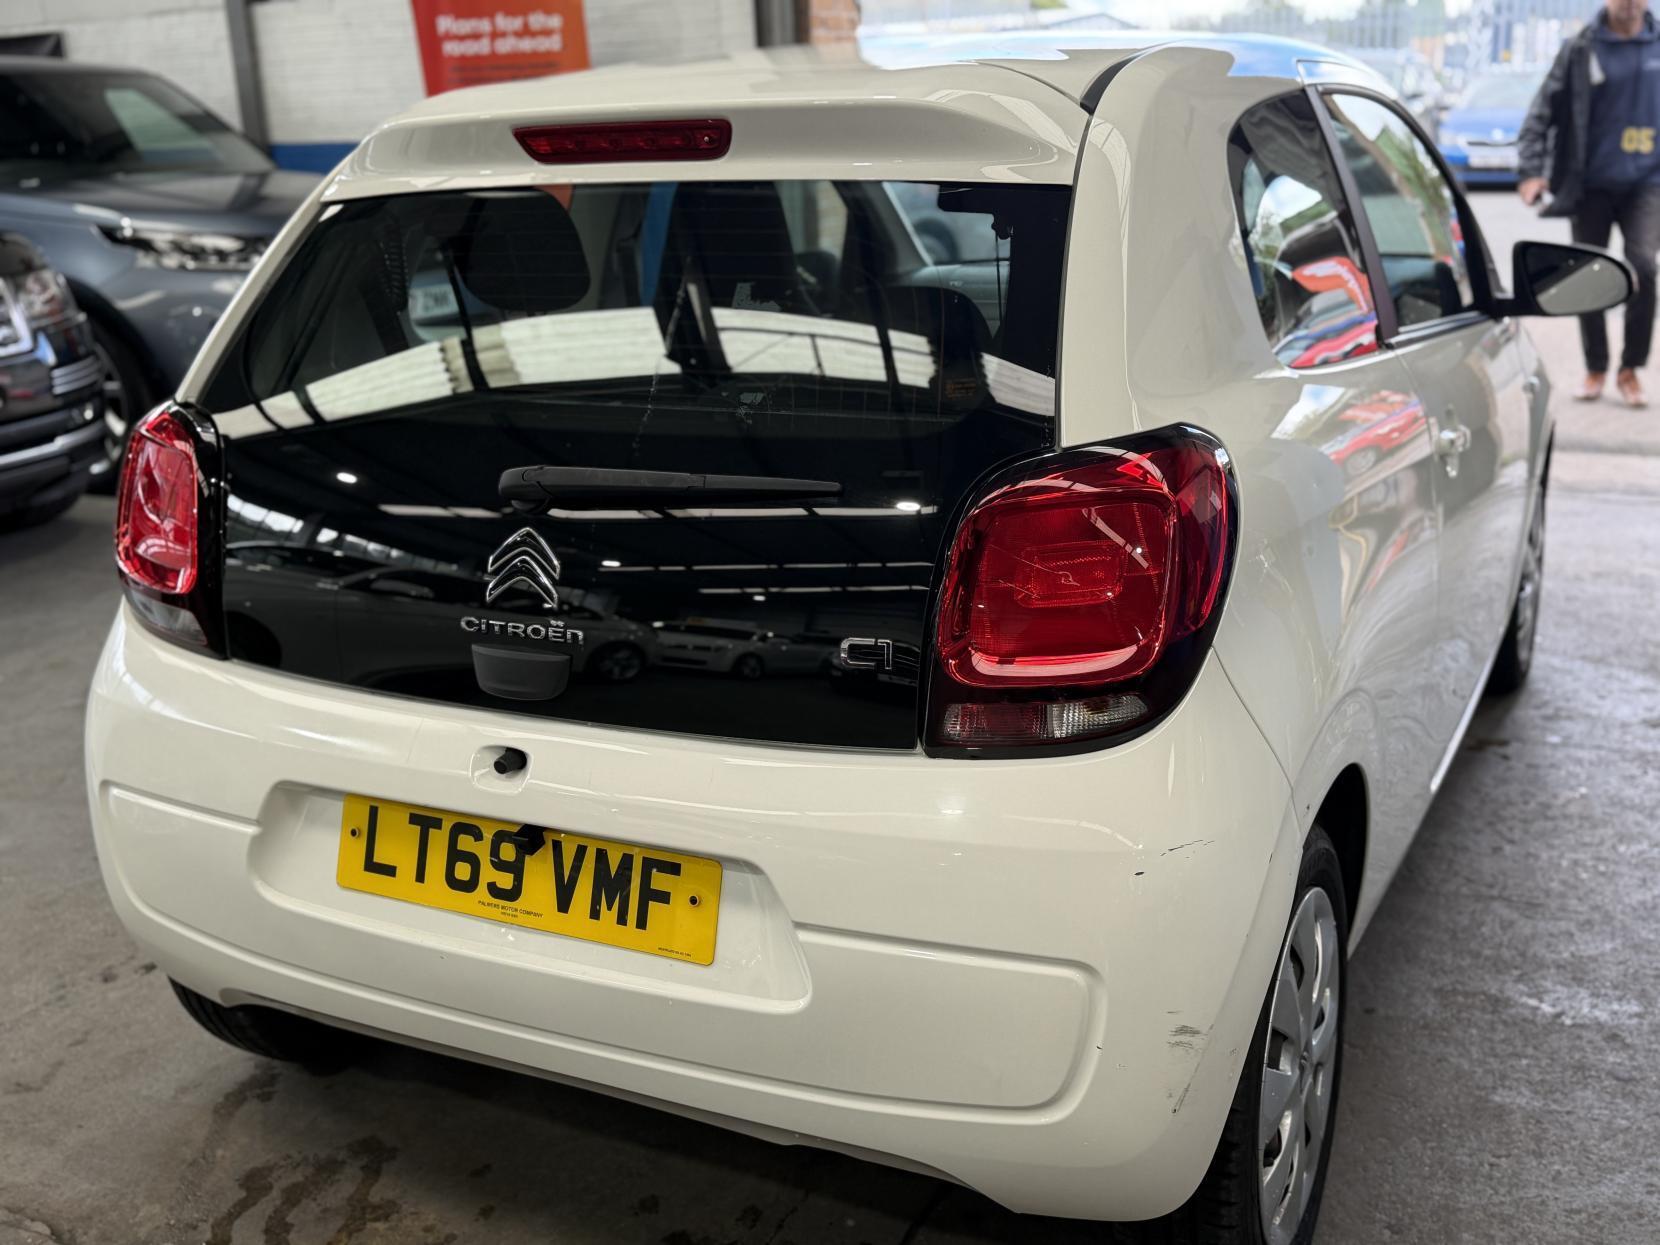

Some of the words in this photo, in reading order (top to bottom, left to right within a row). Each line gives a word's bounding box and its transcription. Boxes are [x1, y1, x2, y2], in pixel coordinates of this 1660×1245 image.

[494, 11, 524, 32] for
[527, 11, 563, 31] the
[442, 36, 491, 57] road
[493, 32, 563, 54] ahead
[840, 636, 893, 670] C1
[363, 804, 528, 903] LT69
[551, 839, 682, 931] VMF
[518, 908, 544, 918] COMPANY
